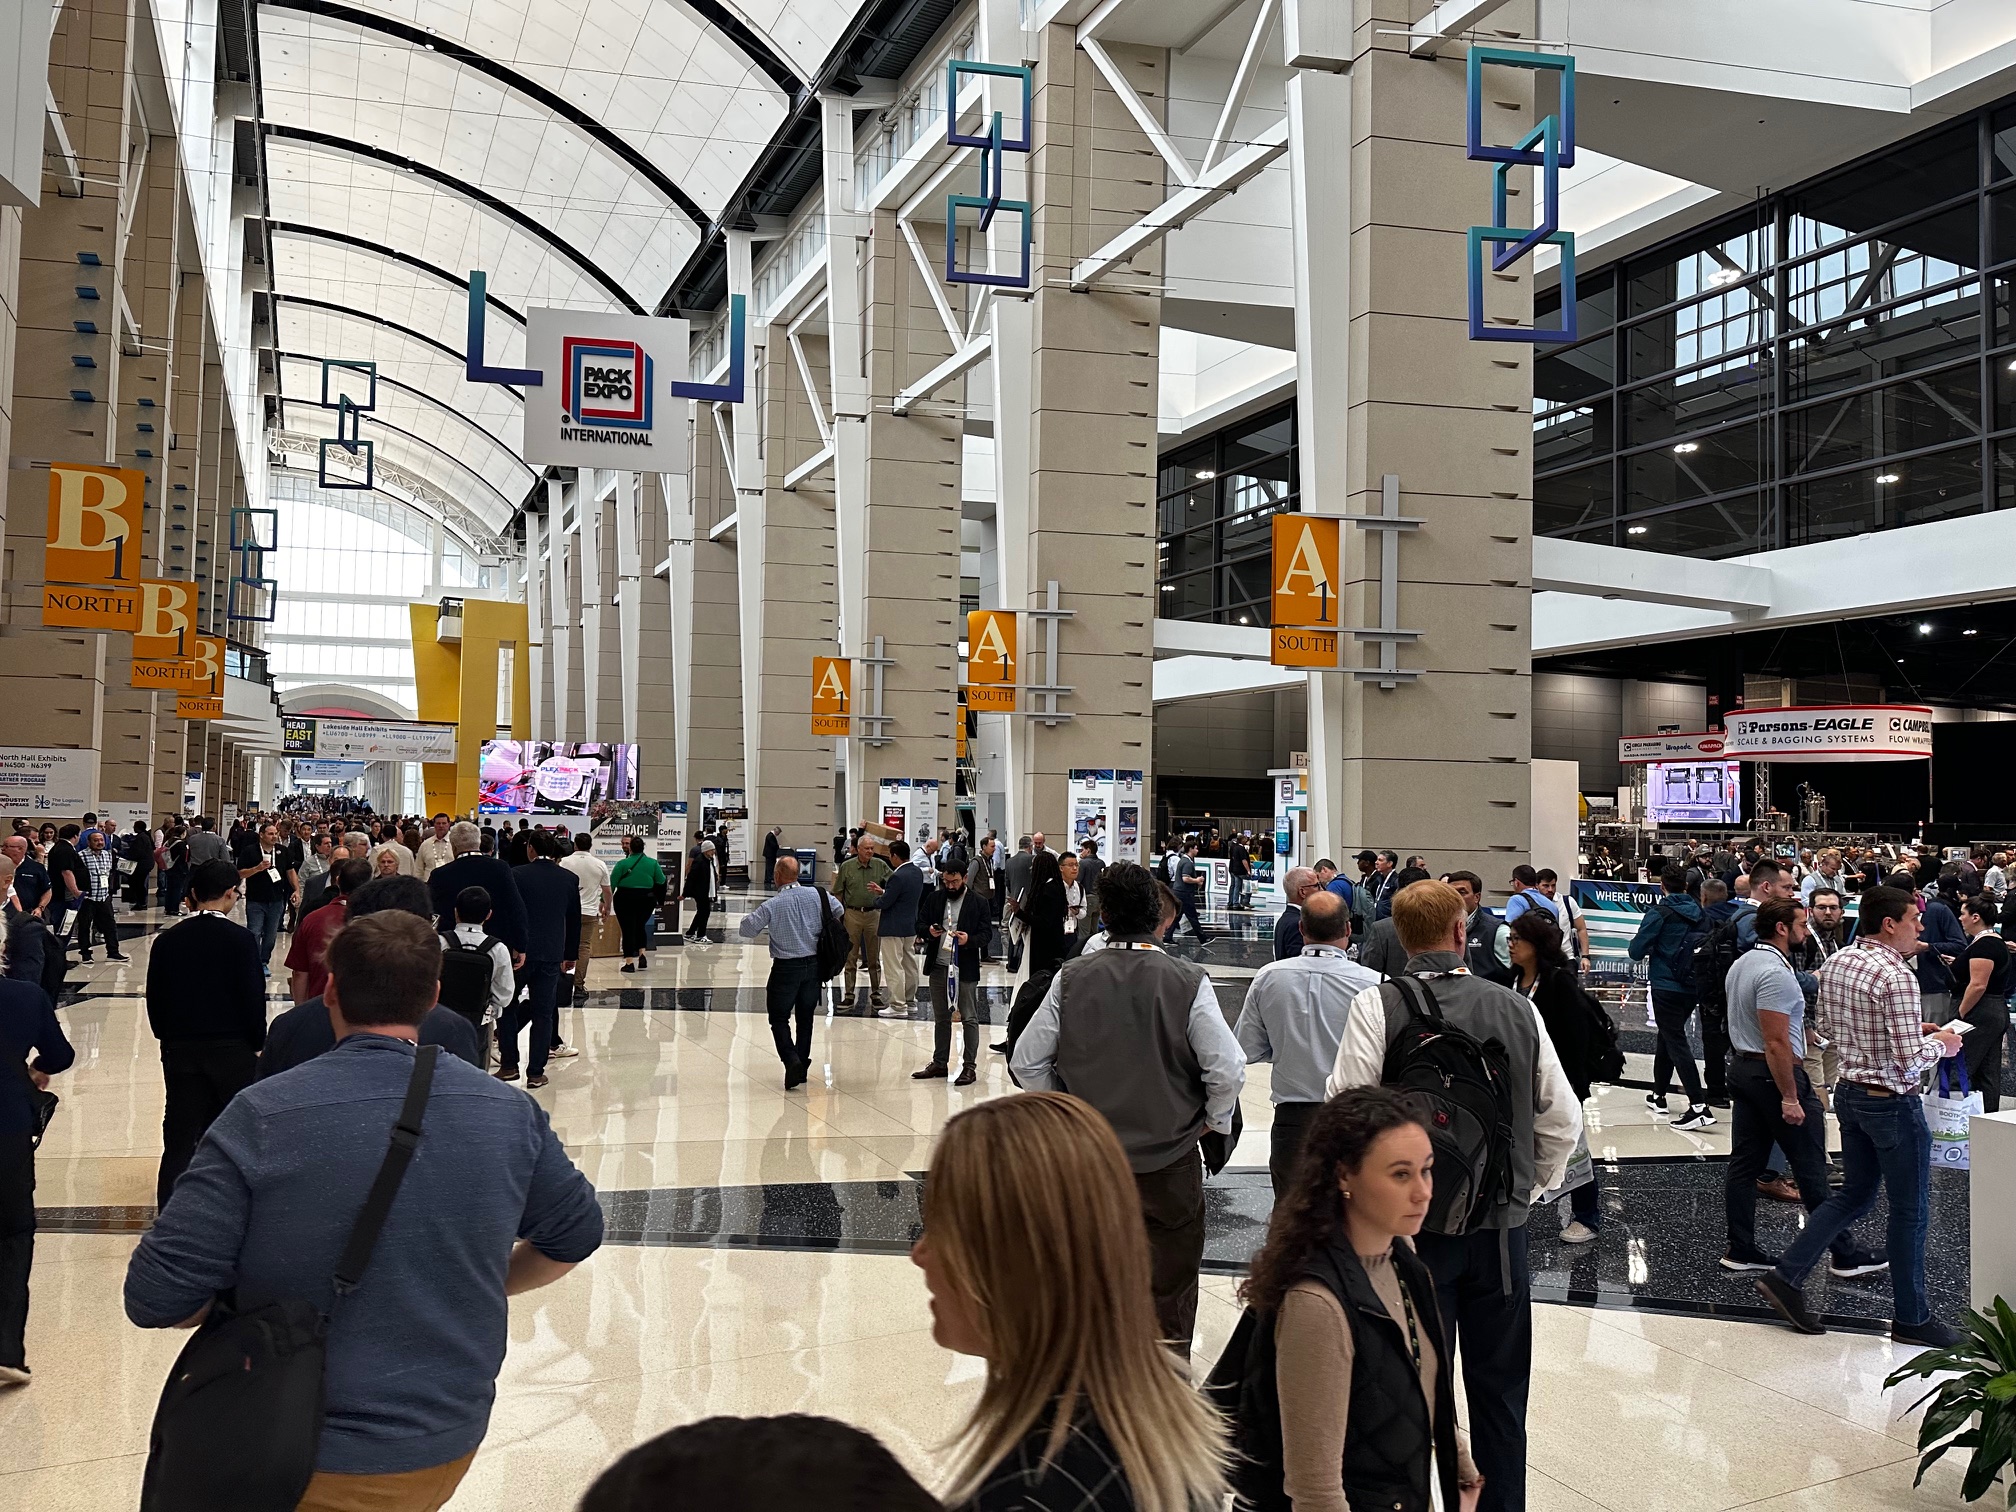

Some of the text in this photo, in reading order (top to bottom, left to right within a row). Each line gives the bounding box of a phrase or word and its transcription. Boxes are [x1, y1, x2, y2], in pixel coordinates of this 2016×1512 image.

[584, 366, 632, 386] PACK
[584, 384, 632, 400] EXPO
[560, 427, 653, 446] INTERNATIONAL
[47, 593, 133, 614] NORTH
[1278, 635, 1334, 653] SOUTH
[134, 665, 191, 679] NORTH
[971, 690, 1013, 702] SOUTH
[178, 701, 221, 712] NORTH
[286, 721, 306, 730] HEAD
[323, 723, 349, 731] Lakeside
[814, 719, 848, 728] SOUTH
[1749, 718, 1874, 733] Parsons-EAGLE
[286, 730, 312, 741] EAST
[1737, 737, 1759, 746] SCALE
[1762, 737, 1768, 745] &
[1772, 736, 1822, 745] BAGGING
[1827, 735, 1875, 743] SYSTEMS
[1889, 735, 1911, 743] FLOW
[285, 740, 303, 748] FOR:
[624, 823, 649, 836] RACE
[1259, 869, 1269, 877] YOU
[1596, 890, 1630, 903] WHERE
[1632, 893, 1652, 904] YOU
